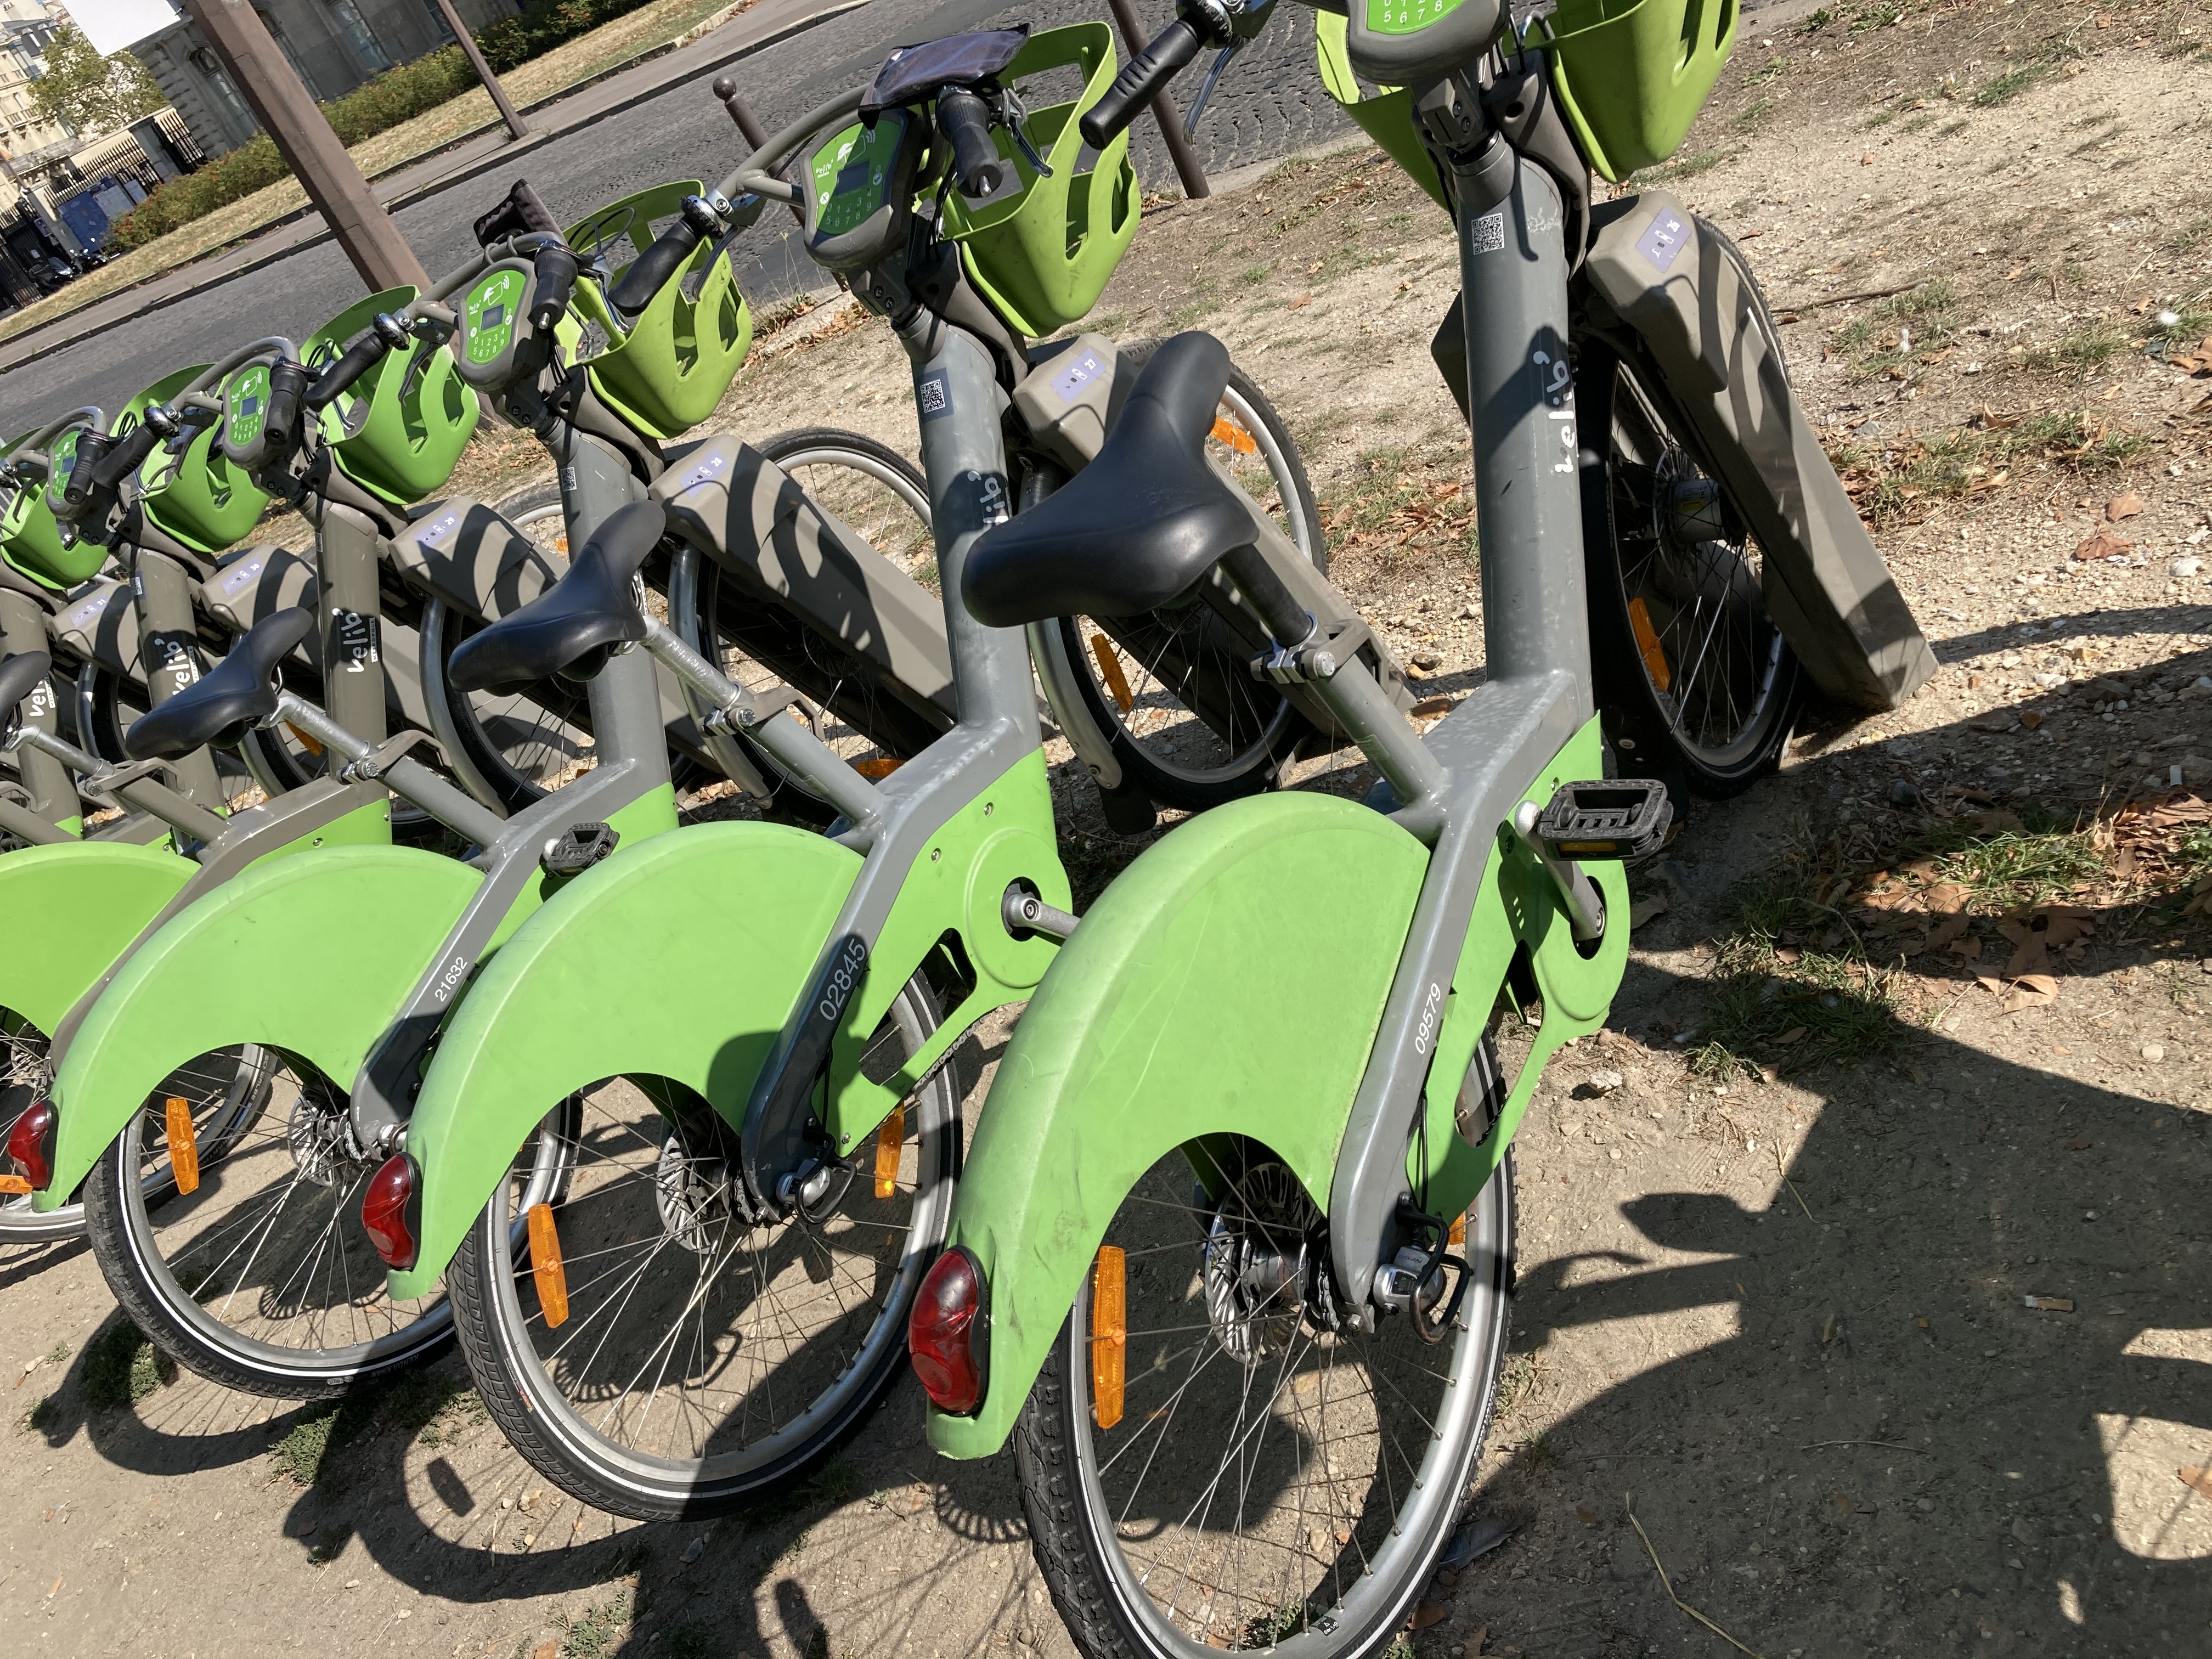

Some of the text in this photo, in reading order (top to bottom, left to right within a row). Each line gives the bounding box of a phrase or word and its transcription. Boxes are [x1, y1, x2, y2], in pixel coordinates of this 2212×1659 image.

[1384, 0, 1442, 24] 5 6 7 8
[826, 201, 872, 227] 5 6 7 8 9
[827, 203, 832, 212] 0
[837, 205, 840, 214] 1
[857, 197, 862, 207] 3
[1666, 219, 1680, 233] 26
[475, 336, 479, 345] 0
[487, 337, 492, 346] 2
[494, 334, 498, 342] 3
[501, 327, 505, 335] 4
[486, 349, 490, 357] 7
[493, 345, 496, 353] 8
[500, 338, 504, 347] 9
[1084, 358, 1096, 370] 27
[967, 471, 1009, 523] lib'
[250, 563, 260, 571] 30
[332, 608, 368, 673] velib'
[154, 638, 190, 696] velib'
[189, 648, 199, 682] ETROPOLE
[435, 956, 468, 1002] 21632
[820, 938, 866, 1021] 02845
[1415, 983, 1441, 1054] 09579
